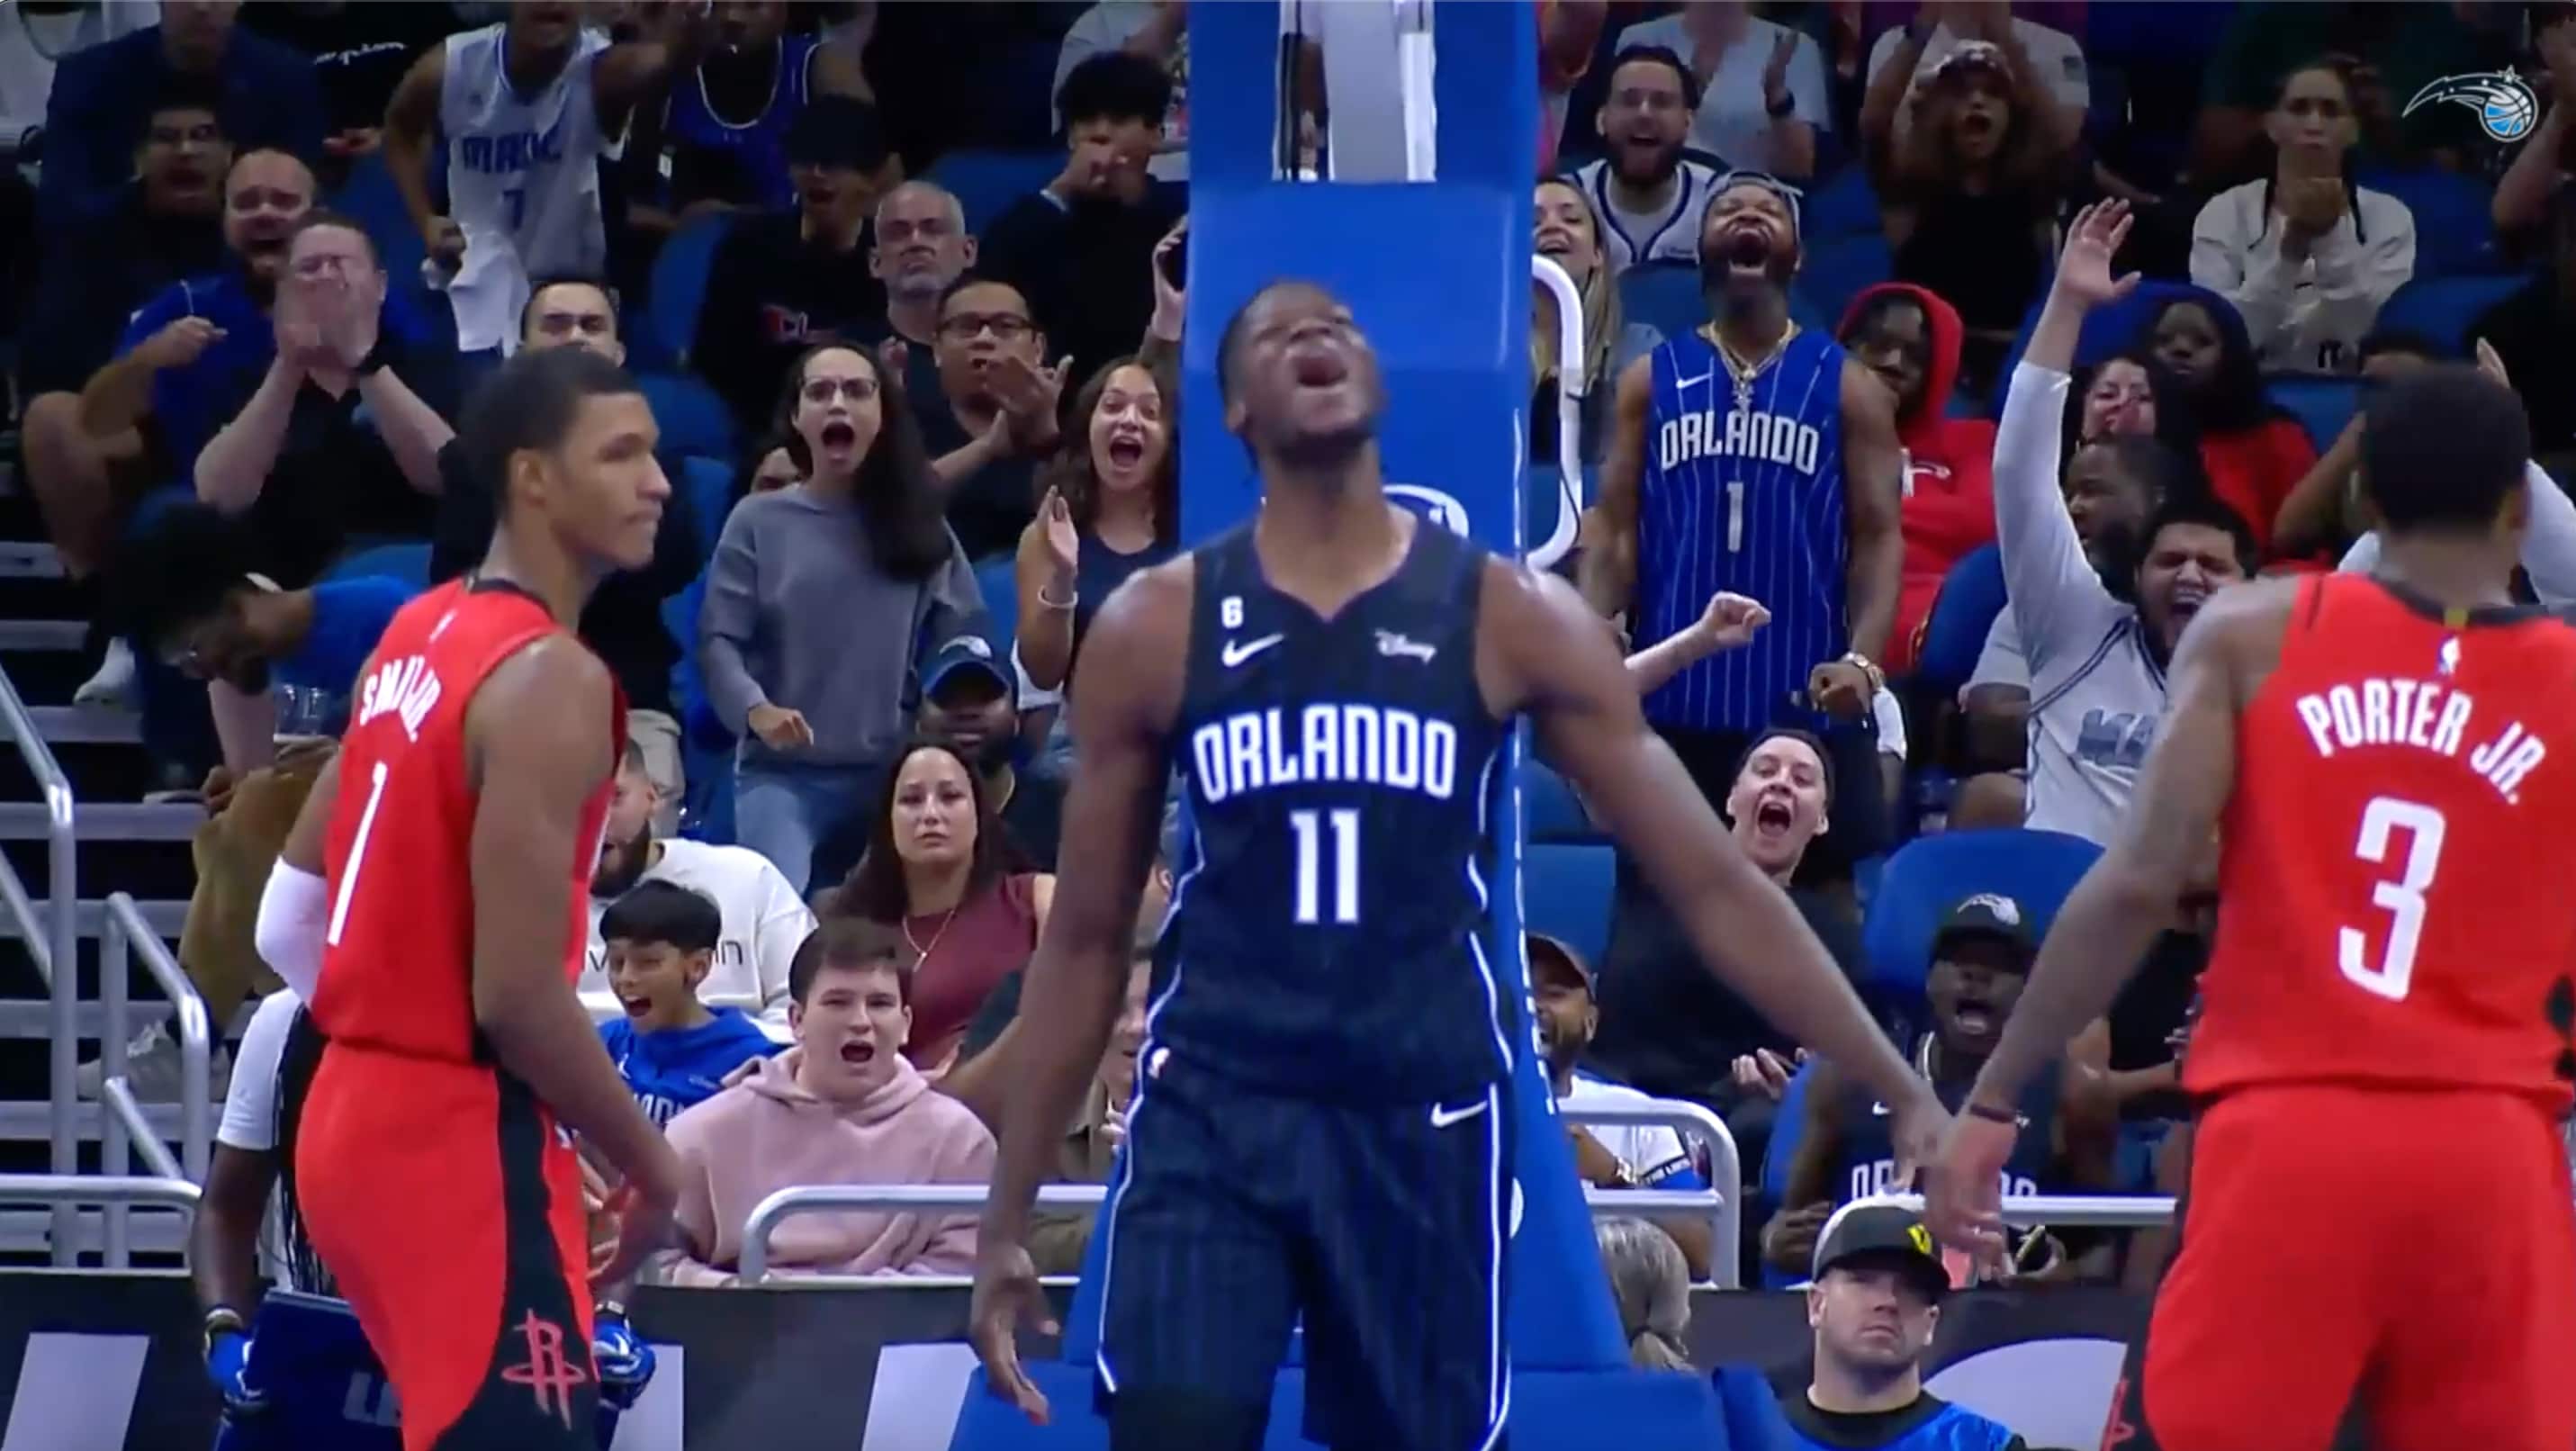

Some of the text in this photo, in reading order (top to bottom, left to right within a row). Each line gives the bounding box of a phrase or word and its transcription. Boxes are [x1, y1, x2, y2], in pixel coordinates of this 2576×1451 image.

[1661, 410, 1820, 475] ORLANDO
[1726, 482, 1743, 553] 1
[1220, 597, 1243, 628] 6
[1193, 704, 1457, 803] ORLANDO
[2296, 678, 2546, 805] PORTER JR.
[328, 761, 388, 946] 1
[1290, 809, 1358, 924] 11
[2339, 797, 2446, 1003] 3
